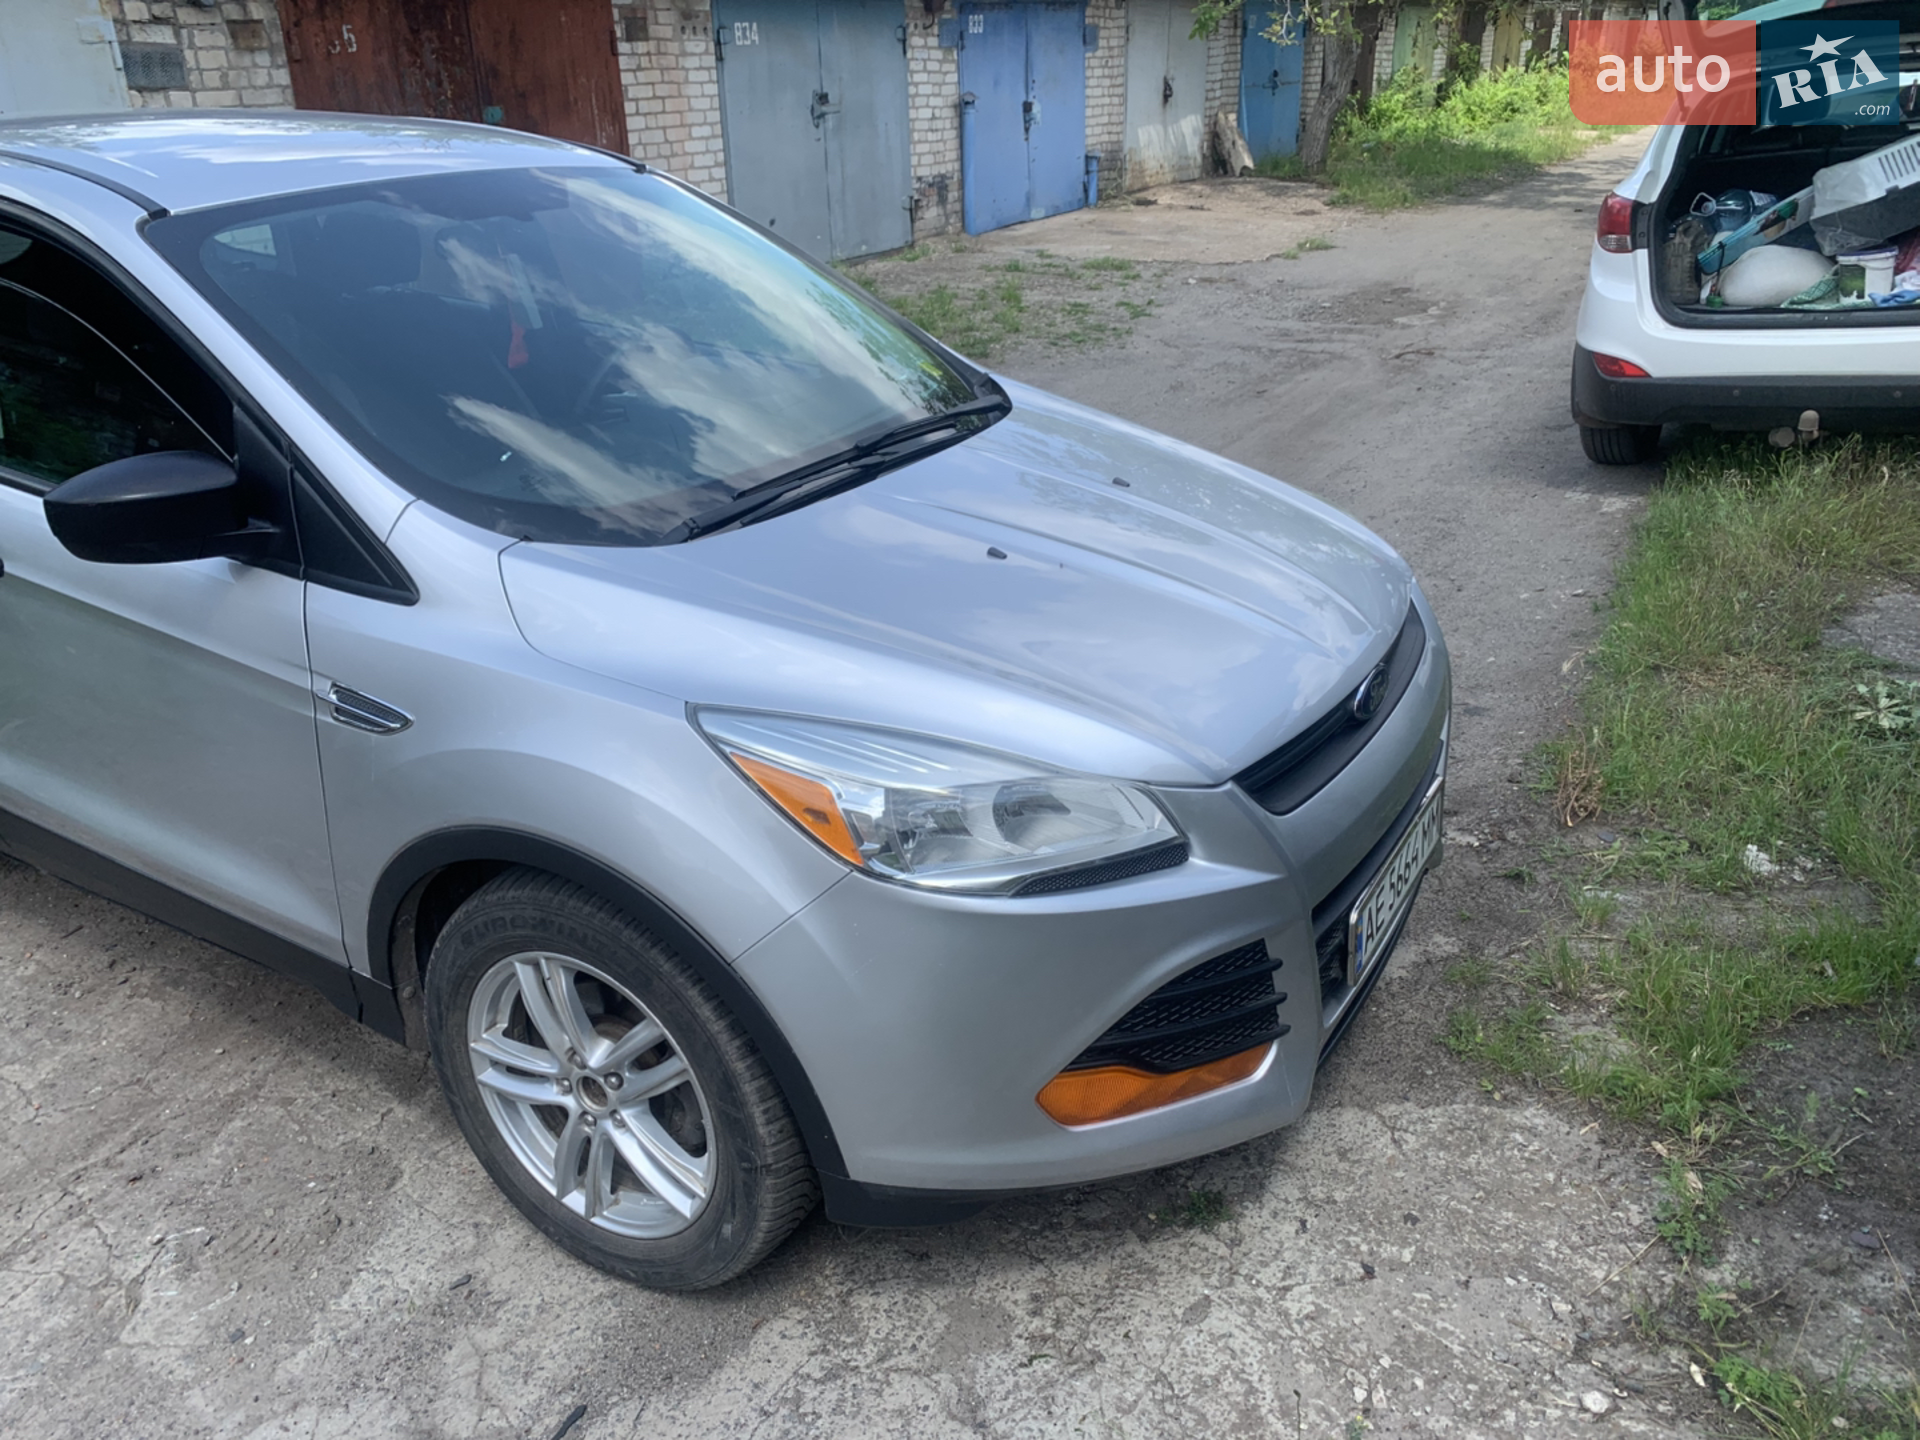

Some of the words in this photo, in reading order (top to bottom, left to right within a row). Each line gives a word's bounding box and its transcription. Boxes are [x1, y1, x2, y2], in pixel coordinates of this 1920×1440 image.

[734, 22, 759, 45] 834
[1365, 885, 1385, 953] AE
[1387, 831, 1419, 911] 5664
